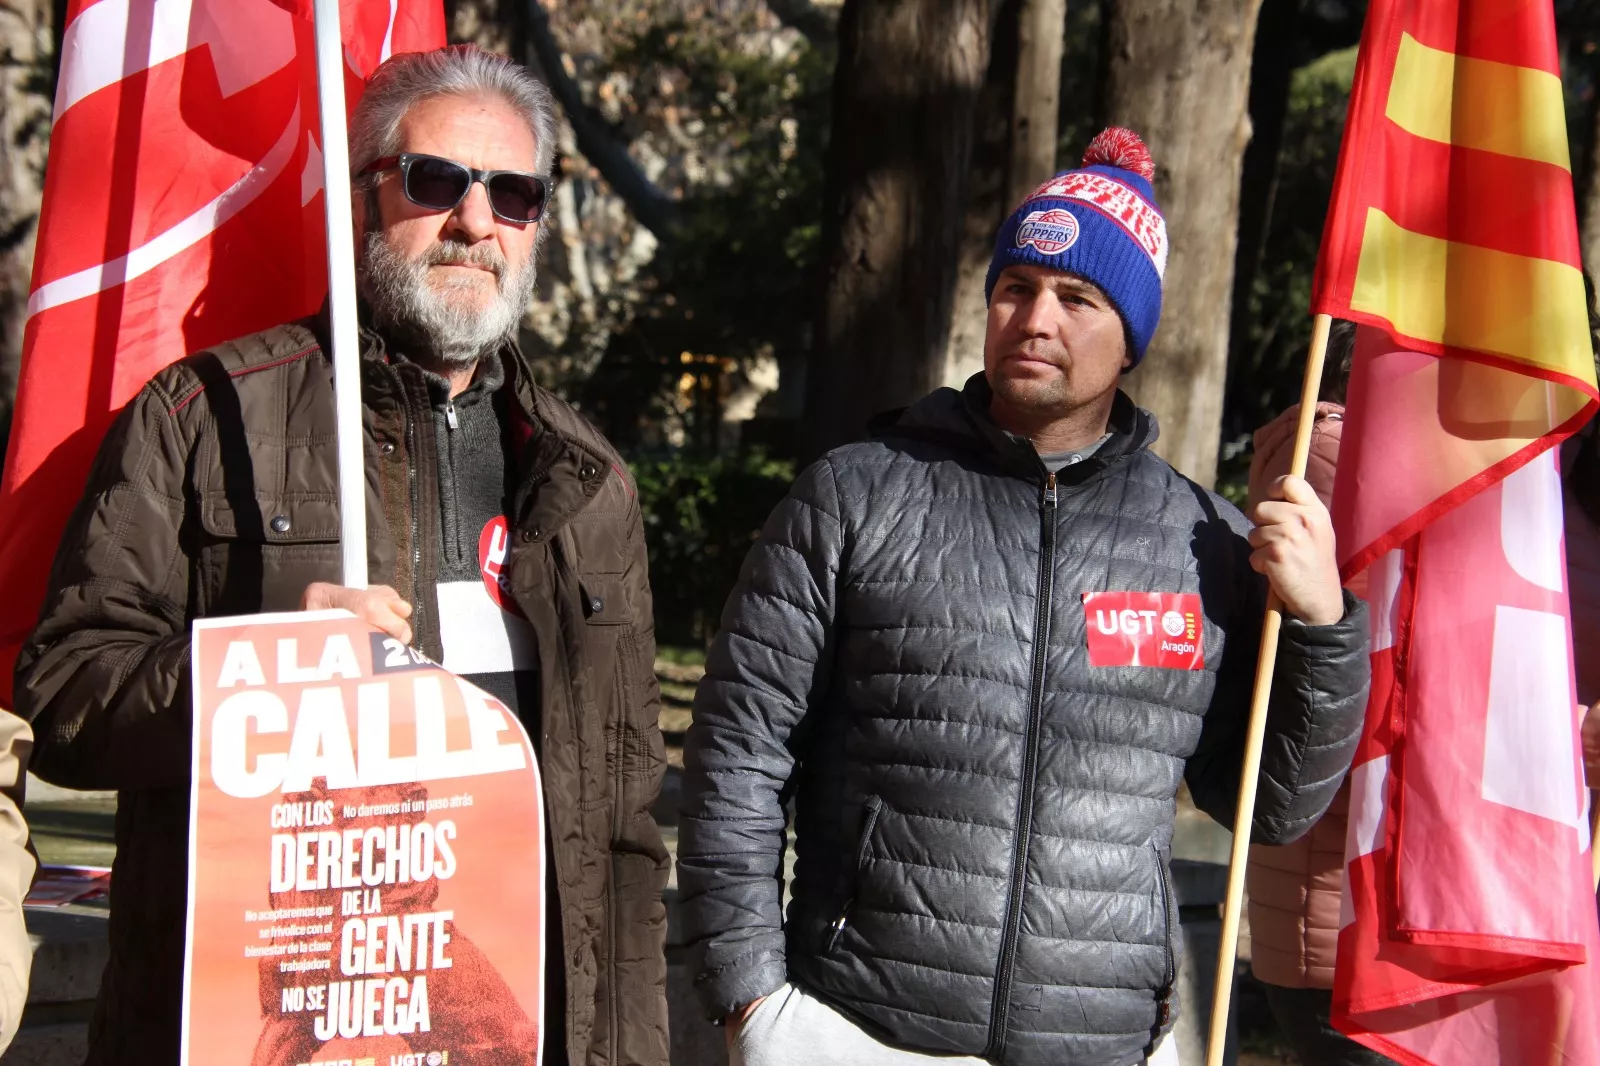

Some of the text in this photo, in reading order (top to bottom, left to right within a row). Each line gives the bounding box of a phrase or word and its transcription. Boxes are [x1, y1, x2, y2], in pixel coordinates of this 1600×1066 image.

[1017, 222, 1071, 246] CLIPPERS
[1096, 609, 1157, 635] UGT
[1161, 640, 1194, 654] Aragón
[217, 634, 362, 688] A LA
[211, 674, 526, 798] CALLE
[271, 800, 334, 828] CON LOS
[343, 793, 474, 819] No daremos ni un paso atrás
[270, 820, 457, 893] DERECHOS
[245, 906, 334, 922] No aceptaremos que
[342, 890, 381, 916] DE LA
[259, 922, 332, 938] se frivolice con el
[245, 940, 332, 957] bienestar de la clase
[340, 911, 454, 976] GENTE
[280, 960, 331, 973] trabajadora
[281, 984, 326, 1012] NO SE
[313, 976, 431, 1041] JUEGA
[390, 1053, 426, 1066] UGT
